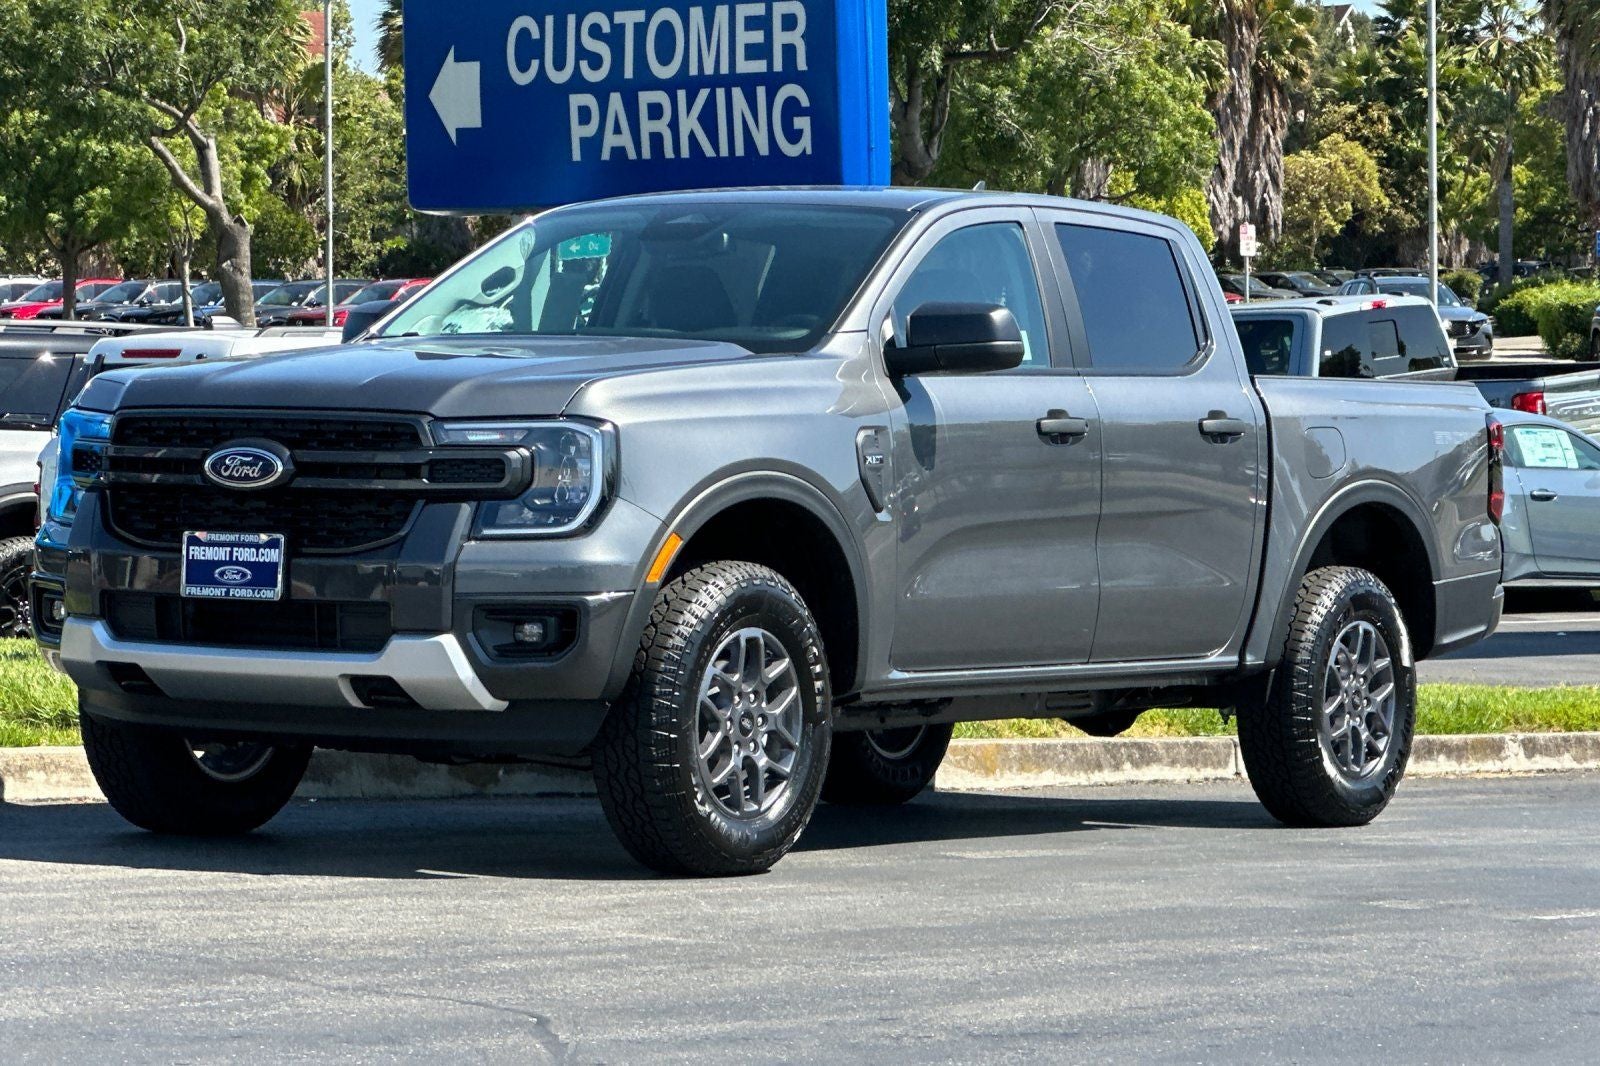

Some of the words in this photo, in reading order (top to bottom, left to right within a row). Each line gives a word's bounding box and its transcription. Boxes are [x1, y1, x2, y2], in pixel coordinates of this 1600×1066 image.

[506, 0, 808, 86] CUSTOMER
[568, 83, 813, 162] PARKING
[221, 455, 263, 478] Ford
[207, 533, 239, 543] FREMONT
[240, 534, 260, 543] FORD
[189, 545, 231, 561] FREMONT
[232, 547, 279, 563] FORD.COM
[223, 569, 242, 580] Ford
[185, 587, 227, 597] FREMONT
[229, 588, 275, 599] FORD.COM
